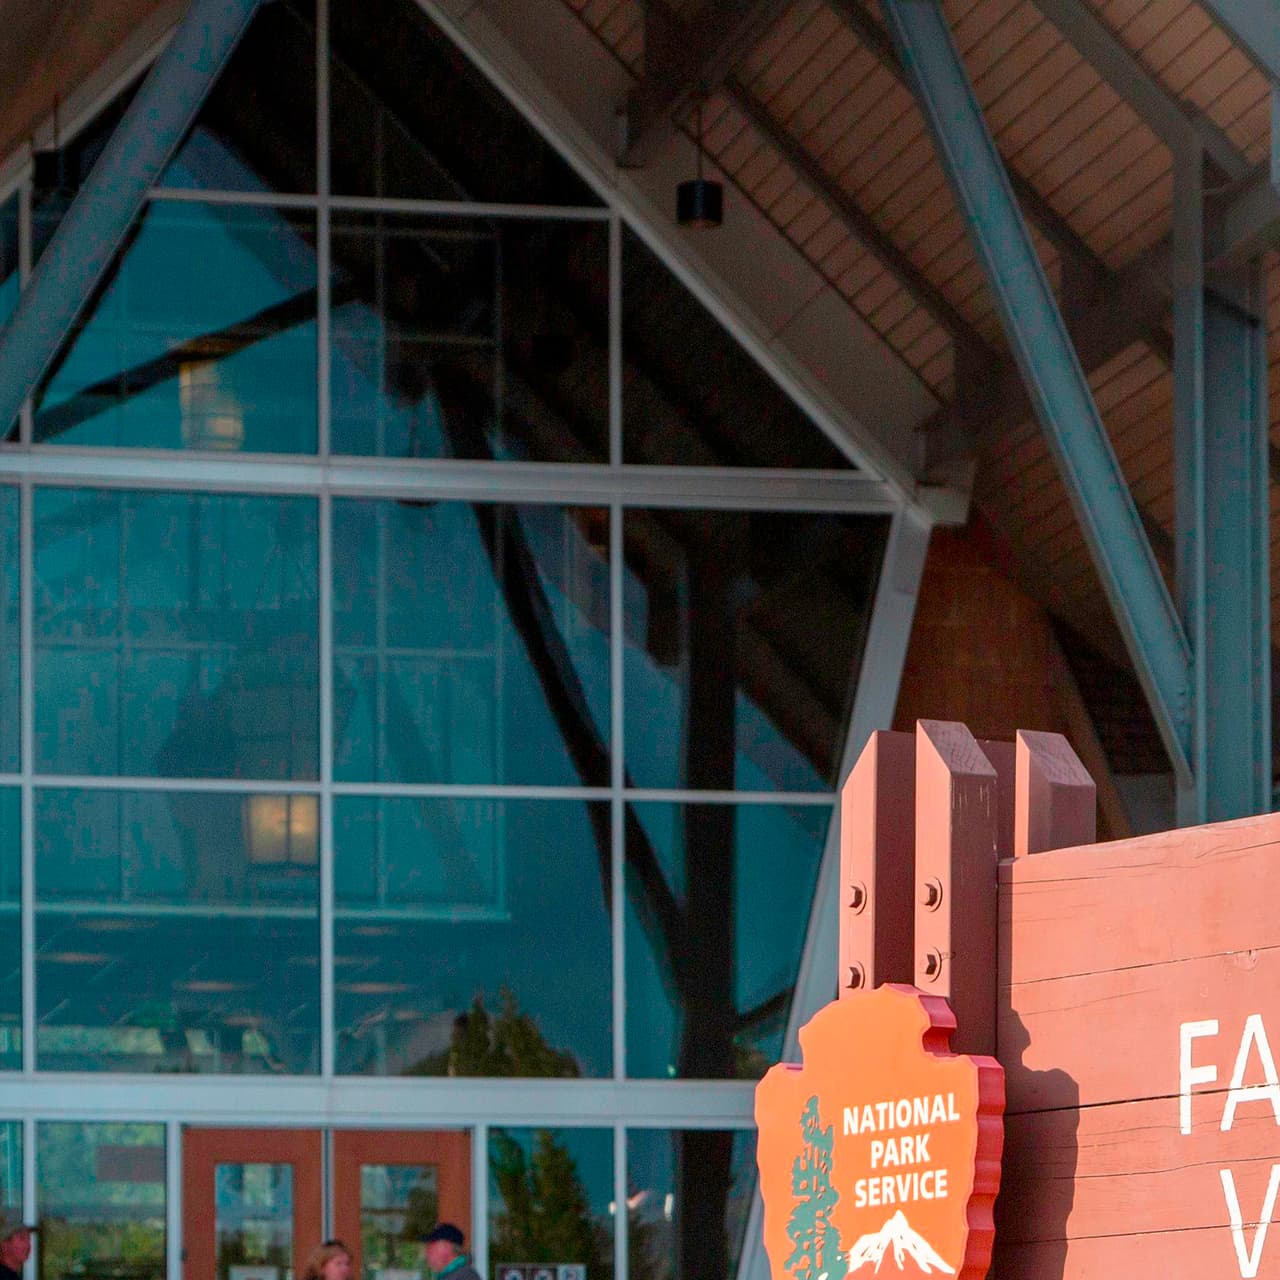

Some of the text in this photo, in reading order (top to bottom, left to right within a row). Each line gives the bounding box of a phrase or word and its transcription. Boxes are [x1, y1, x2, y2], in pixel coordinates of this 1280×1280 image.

[843, 1092, 961, 1136] NATIONAL
[870, 1133, 931, 1169] PARK
[854, 1169, 948, 1208] SERVICE
